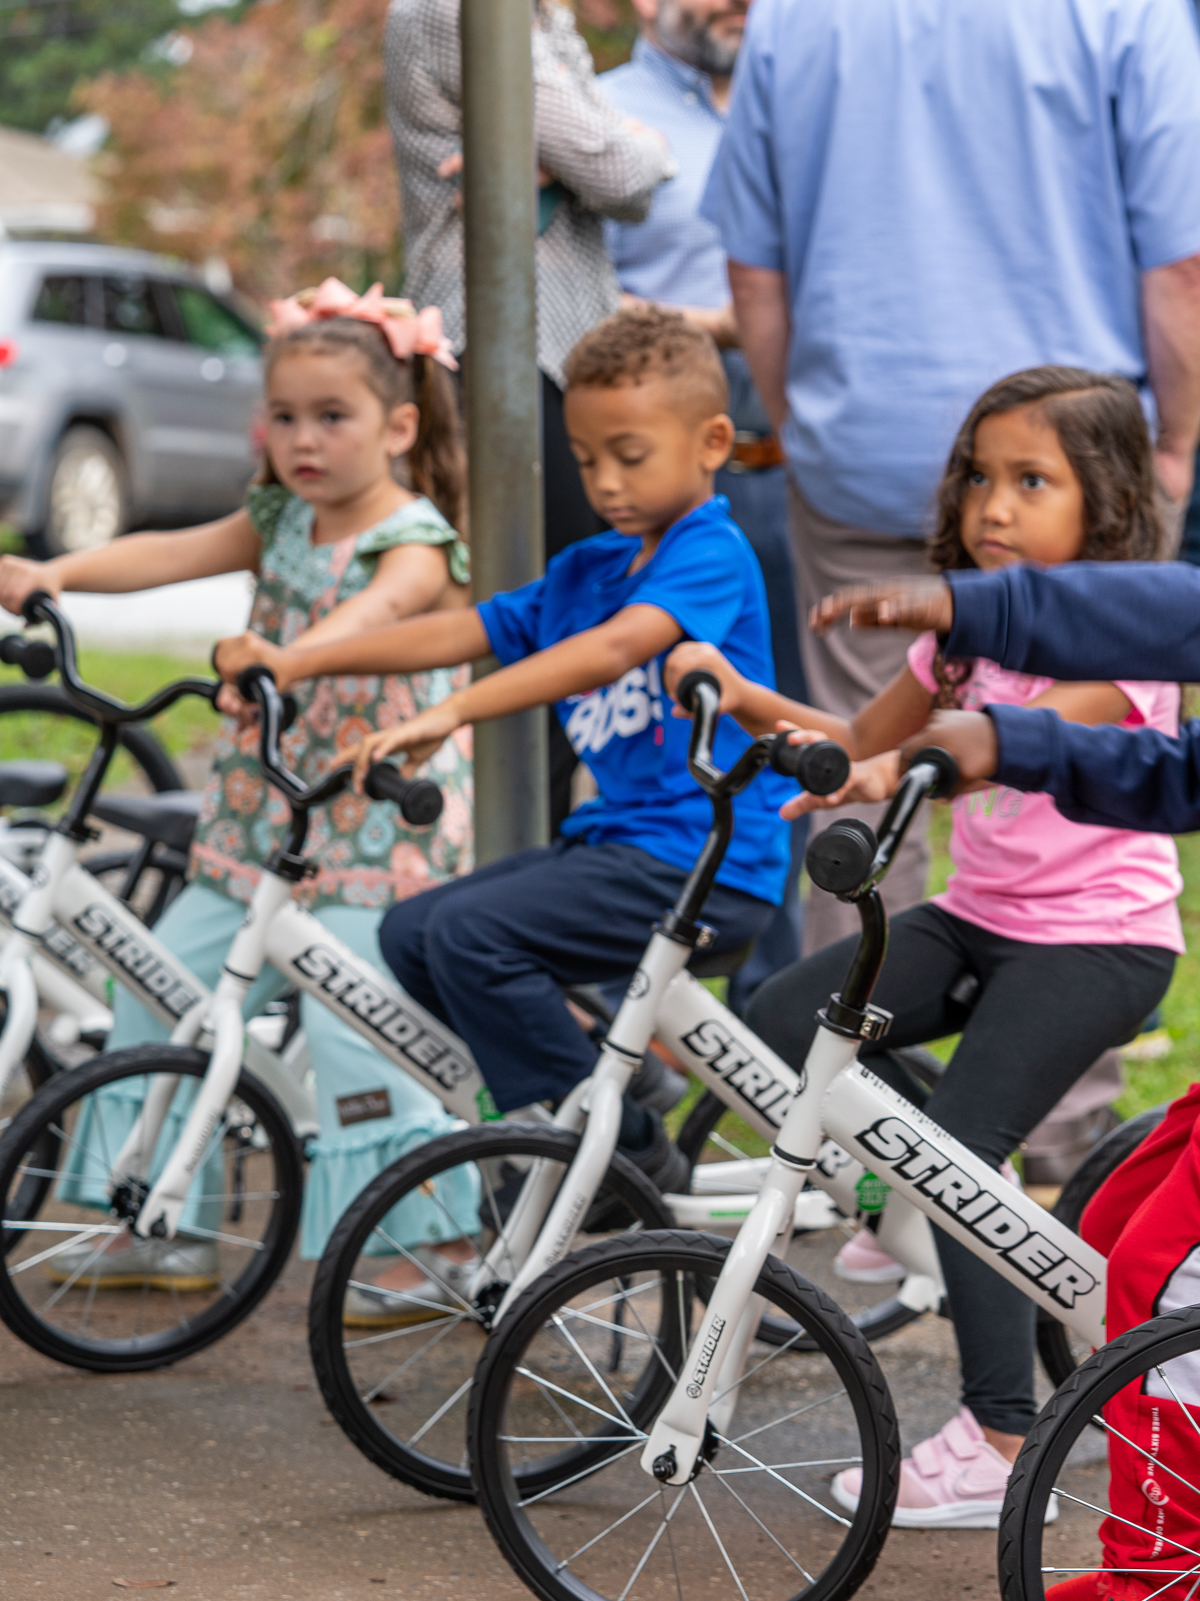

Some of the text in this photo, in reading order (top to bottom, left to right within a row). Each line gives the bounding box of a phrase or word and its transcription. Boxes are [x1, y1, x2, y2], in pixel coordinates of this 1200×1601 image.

[74, 902, 201, 1020] STRIDE
[291, 942, 475, 1092] STRIDER
[680, 1018, 854, 1179] STRIDR
[853, 1116, 1098, 1310] STRIDER
[693, 1315, 727, 1386] STRIDER
[1146, 1459, 1156, 1477] IVE
[1151, 1406, 1161, 1432] THREE
